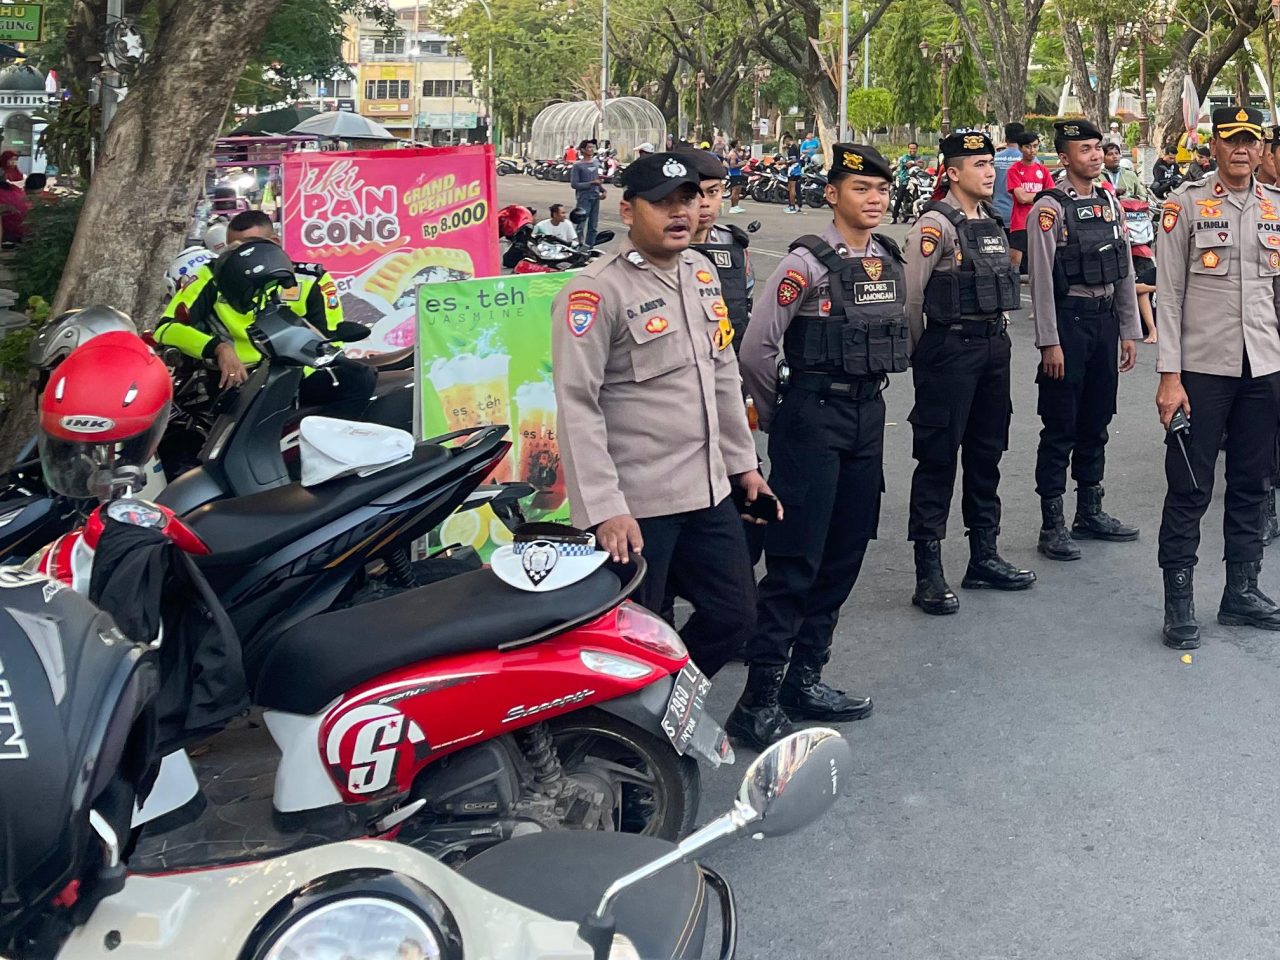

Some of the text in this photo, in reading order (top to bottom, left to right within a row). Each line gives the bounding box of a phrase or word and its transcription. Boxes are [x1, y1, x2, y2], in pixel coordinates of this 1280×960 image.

[301, 185, 398, 220] PAN
[403, 174, 455, 205] GRAND
[408, 180, 481, 217] OPENING
[303, 216, 398, 246] CONG
[423, 202, 486, 239] Rp 8.000
[425, 286, 525, 313] es.teh
[858, 292, 893, 302] LAMONGAN
[863, 283, 888, 292] POLRES
[428, 307, 525, 326] JASMINE
[66, 419, 108, 428] INK
[664, 720, 676, 737] S
[670, 684, 690, 718] 2960
